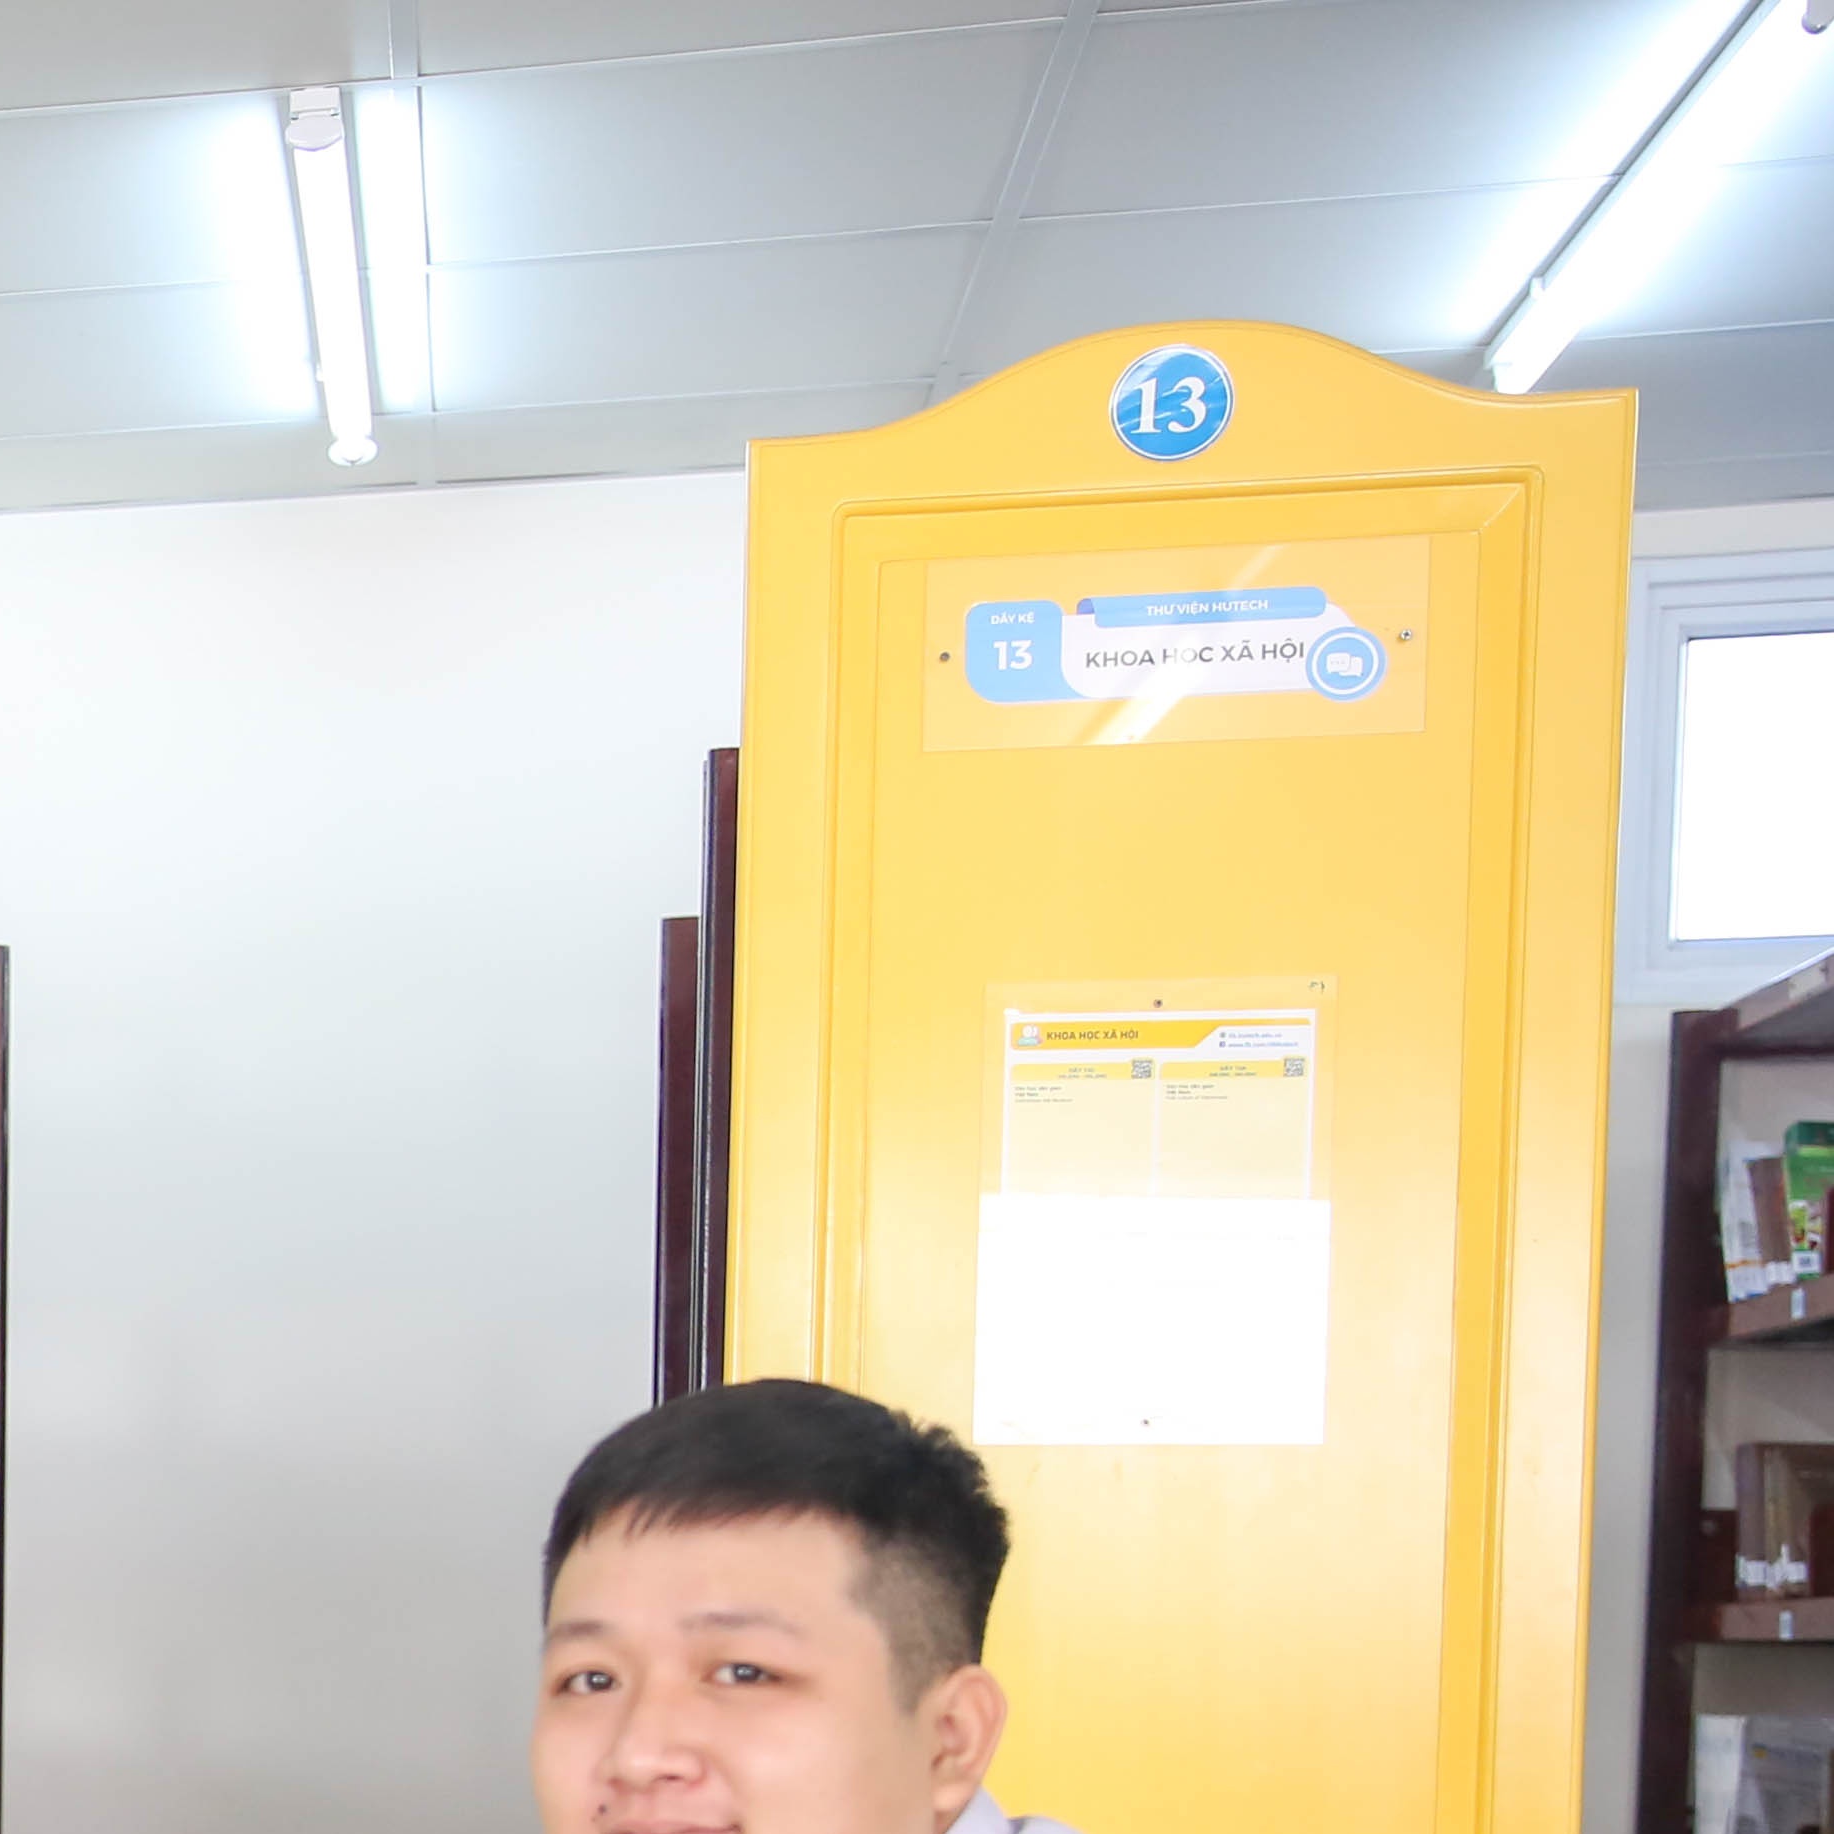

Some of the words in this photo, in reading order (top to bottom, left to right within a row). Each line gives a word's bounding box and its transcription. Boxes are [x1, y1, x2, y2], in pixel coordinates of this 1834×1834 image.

[1131, 375, 1209, 436] 13
[1146, 603, 1177, 616] THƯ
[1178, 601, 1209, 616] VIỆN
[1211, 599, 1269, 613] HUTECH
[992, 640, 1033, 670] 13
[1085, 649, 1156, 669] KHOA
[1162, 646, 1213, 667] HỌC
[1221, 641, 1253, 661] XÃ
[1261, 638, 1305, 662] HỘI
[1047, 1031, 1076, 1041] KHOA
[1078, 1030, 1100, 1042] HỌC
[1103, 1028, 1118, 1040] XÃ
